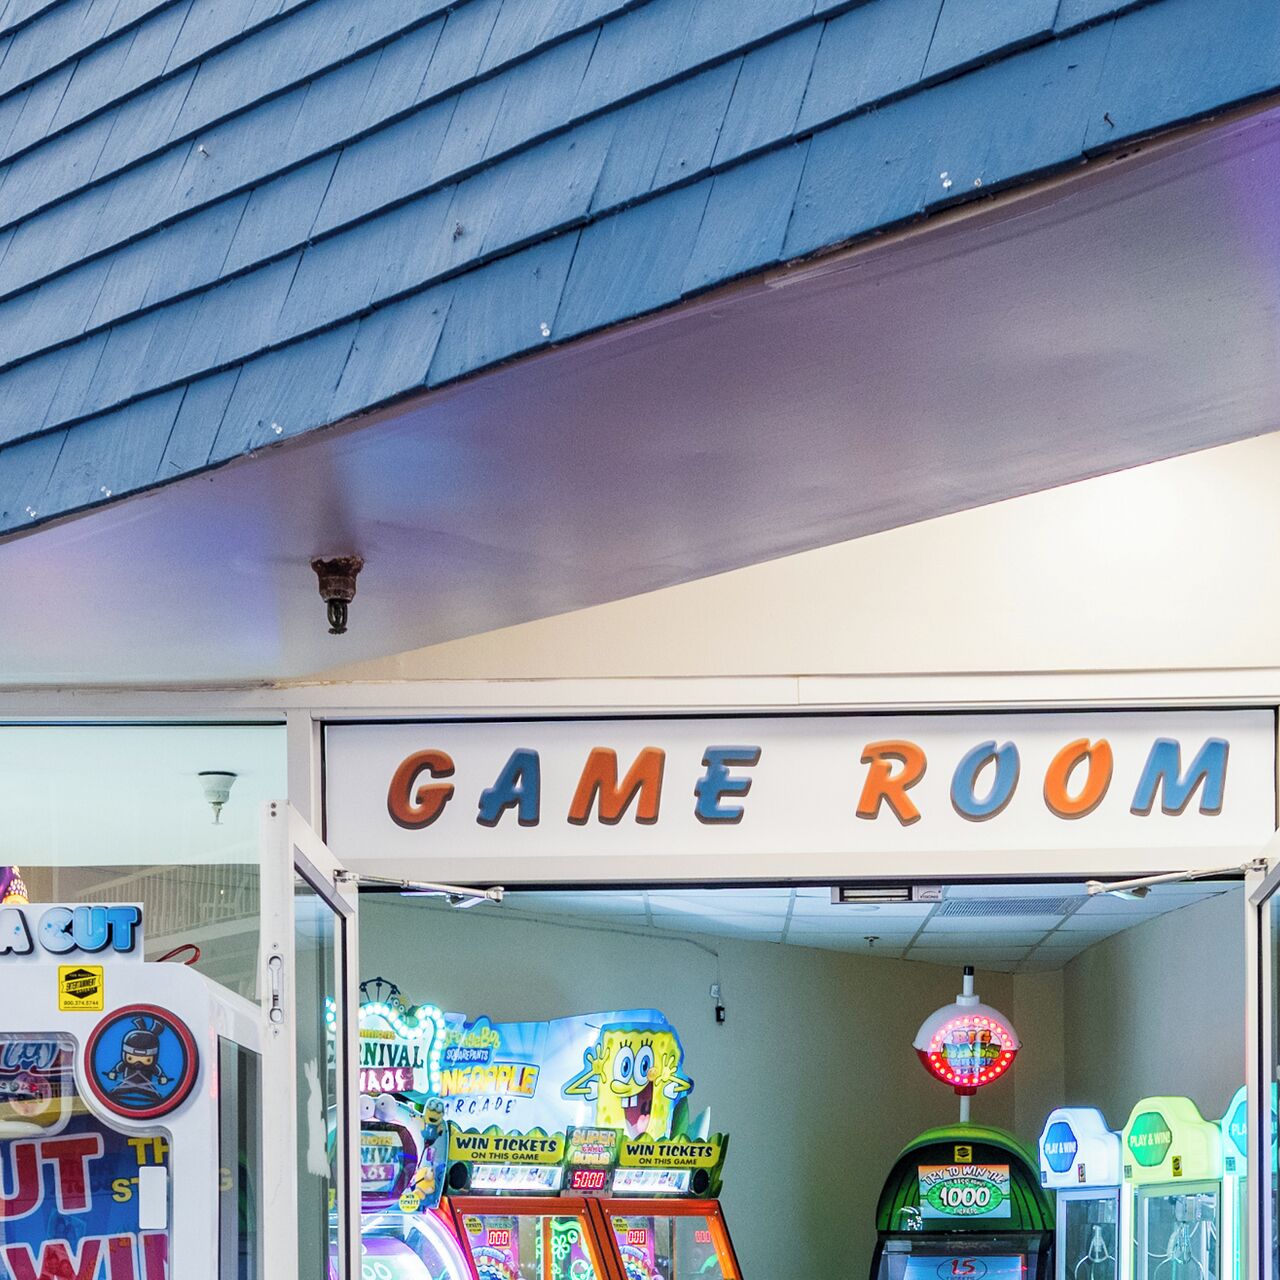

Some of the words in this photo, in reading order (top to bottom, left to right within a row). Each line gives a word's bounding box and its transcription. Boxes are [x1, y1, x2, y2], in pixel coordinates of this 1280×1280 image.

[386, 743, 763, 831] GAME
[853, 735, 1230, 827] ROOM
[37, 906, 141, 954] CUT
[360, 1042, 424, 1069] NIVAL
[455, 1137, 489, 1151] WIN
[494, 1137, 557, 1153] TICKETS
[1045, 1142, 1059, 1153] PLAY
[1130, 1135, 1147, 1148] PLAY
[471, 1151, 487, 1159] ON
[489, 1152, 509, 1160] THIS
[511, 1153, 539, 1161] GAME
[626, 1143, 655, 1156] WIN
[659, 1143, 713, 1158] TICKETS
[654, 1157, 672, 1165] THIS
[673, 1158, 697, 1166] GAME
[573, 1171, 605, 1188] 5000
[922, 1170, 944, 1185] TRY
[945, 1165, 959, 1176] TO
[962, 1165, 986, 1176] WIN
[988, 1170, 1008, 1184] THE
[940, 1187, 991, 1207] 1000
[951, 1258, 976, 1276] 15
